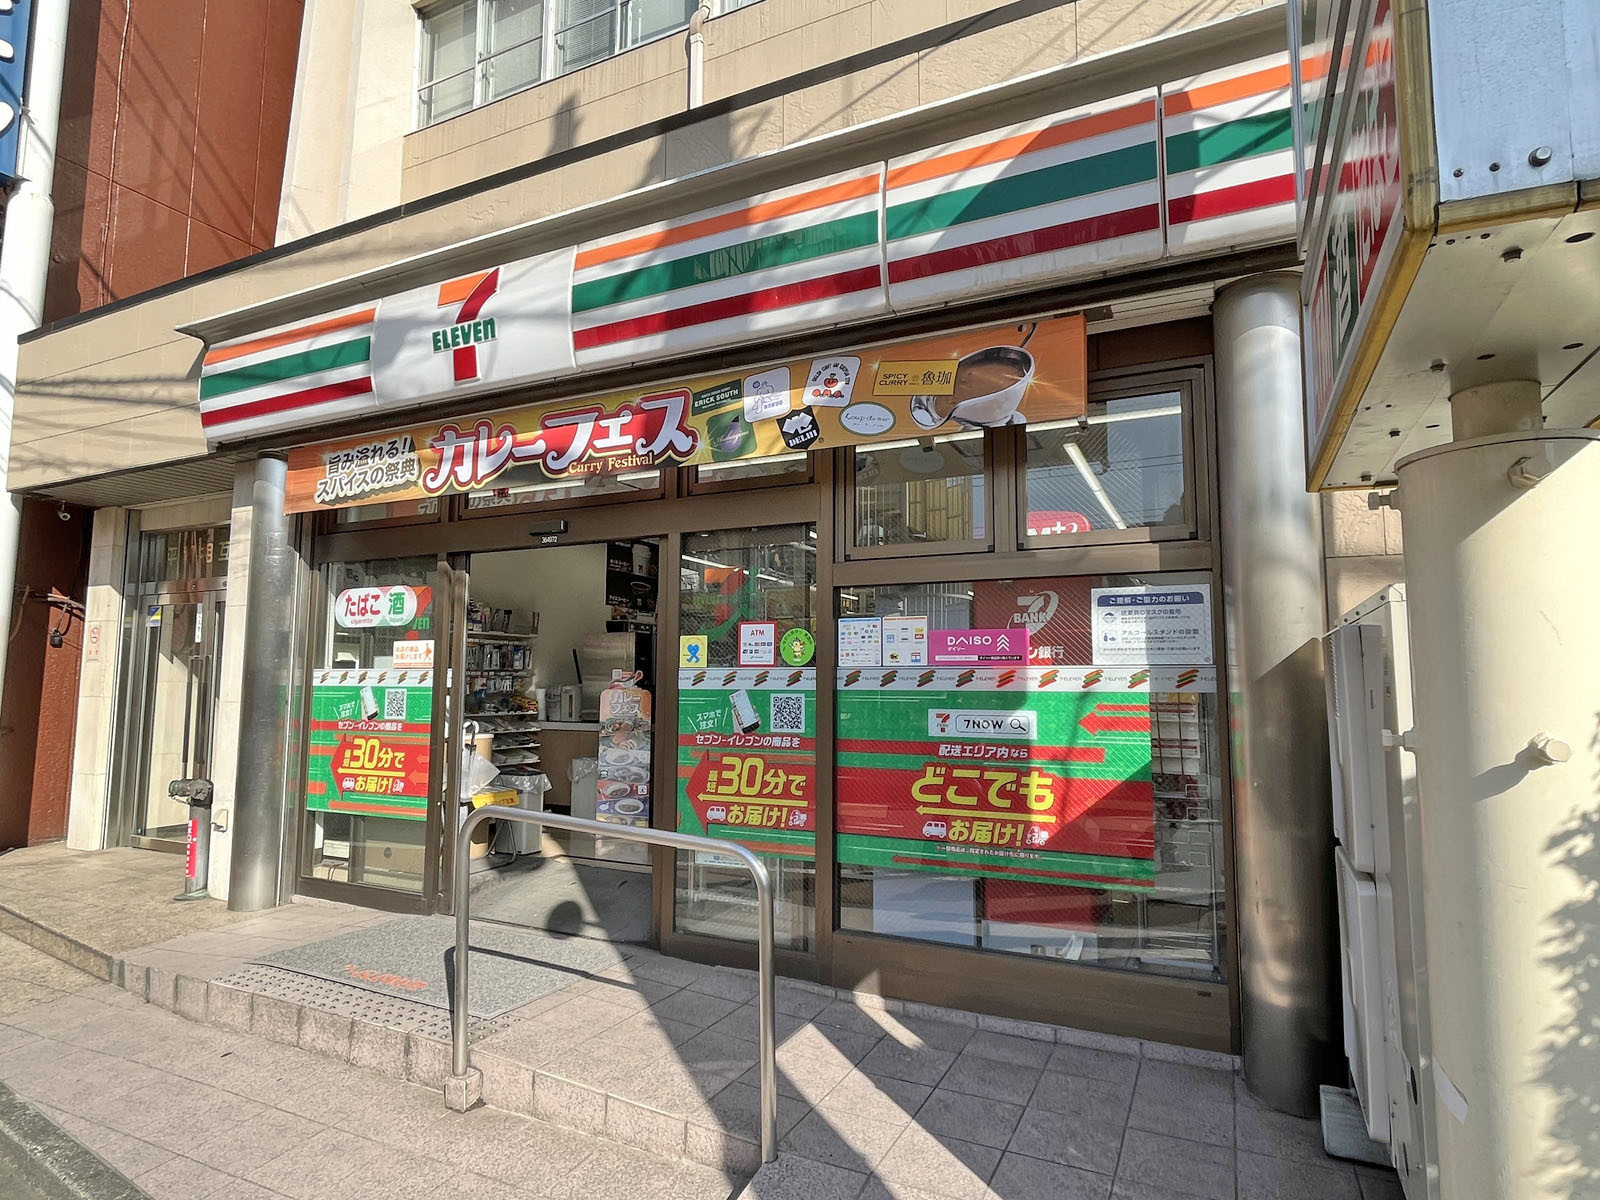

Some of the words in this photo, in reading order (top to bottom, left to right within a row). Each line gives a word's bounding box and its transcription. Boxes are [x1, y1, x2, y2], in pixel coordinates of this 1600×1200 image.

[921, 370, 952, 385] 魯珈
[694, 395, 716, 408] ERICK
[717, 388, 739, 400] SOUTH
[424, 391, 696, 492] カレーフェス
[788, 430, 818, 447] DELHI
[568, 459, 603, 475] Curry
[606, 452, 654, 472] Festival
[316, 457, 416, 499] スパイスの祭典
[344, 592, 381, 617] たばこ
[388, 591, 406, 615] 酒
[1013, 612, 1050, 623] BANK
[750, 629, 765, 637] ATM
[947, 635, 992, 646] DAISO
[1028, 644, 1065, 659] ン銀行
[610, 691, 641, 704] カレー
[610, 704, 642, 715] フェス
[696, 709, 722, 722] スマホで
[963, 720, 1004, 730] 7NOW
[938, 744, 1028, 758] 配送エリア内なら
[354, 776, 393, 793] お届け!
[910, 766, 1058, 811] どこでも
[727, 804, 788, 828] お届け!
[948, 820, 1023, 848] お届け!
